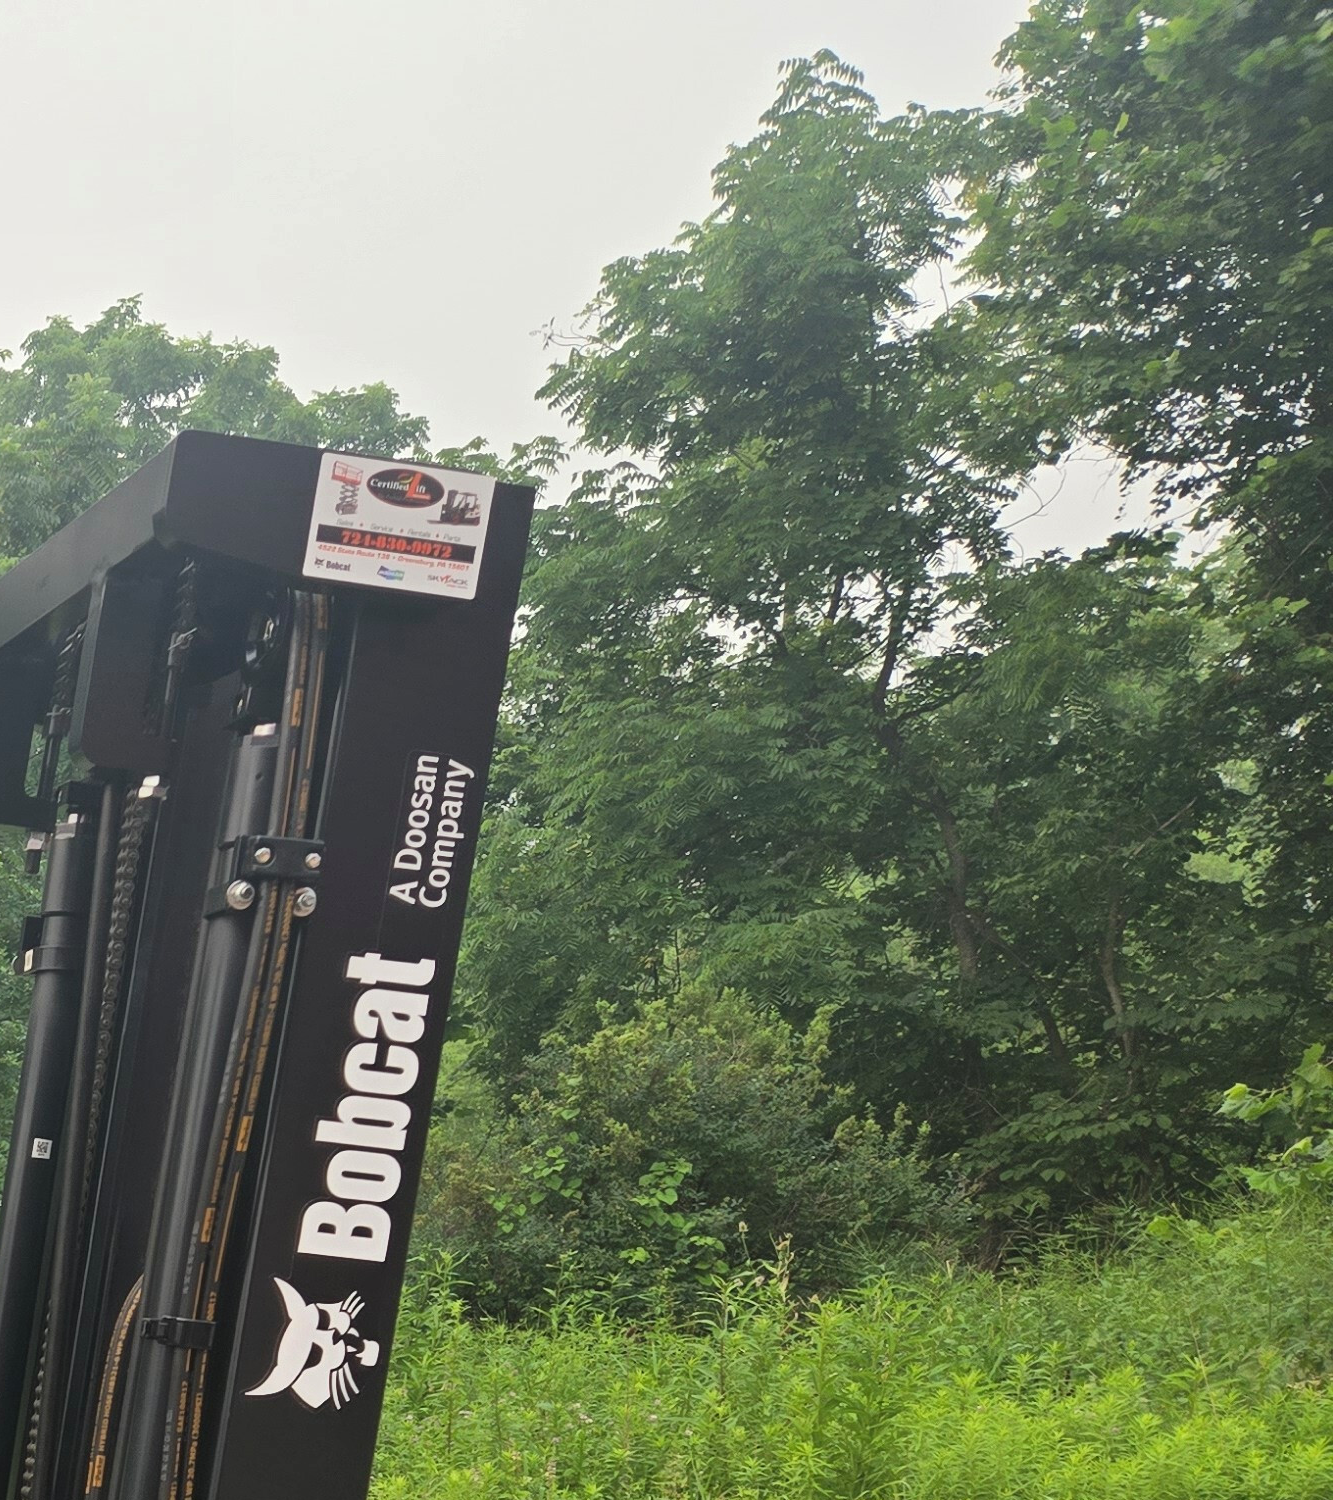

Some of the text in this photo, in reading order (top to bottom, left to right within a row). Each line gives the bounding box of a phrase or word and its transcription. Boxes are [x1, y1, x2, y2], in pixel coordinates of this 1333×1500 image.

[370, 478, 409, 491] Certified
[326, 560, 351, 571] Bobcat
[390, 754, 440, 905] A Doosan
[419, 758, 475, 909] Company
[297, 951, 435, 1263] Bobcat
